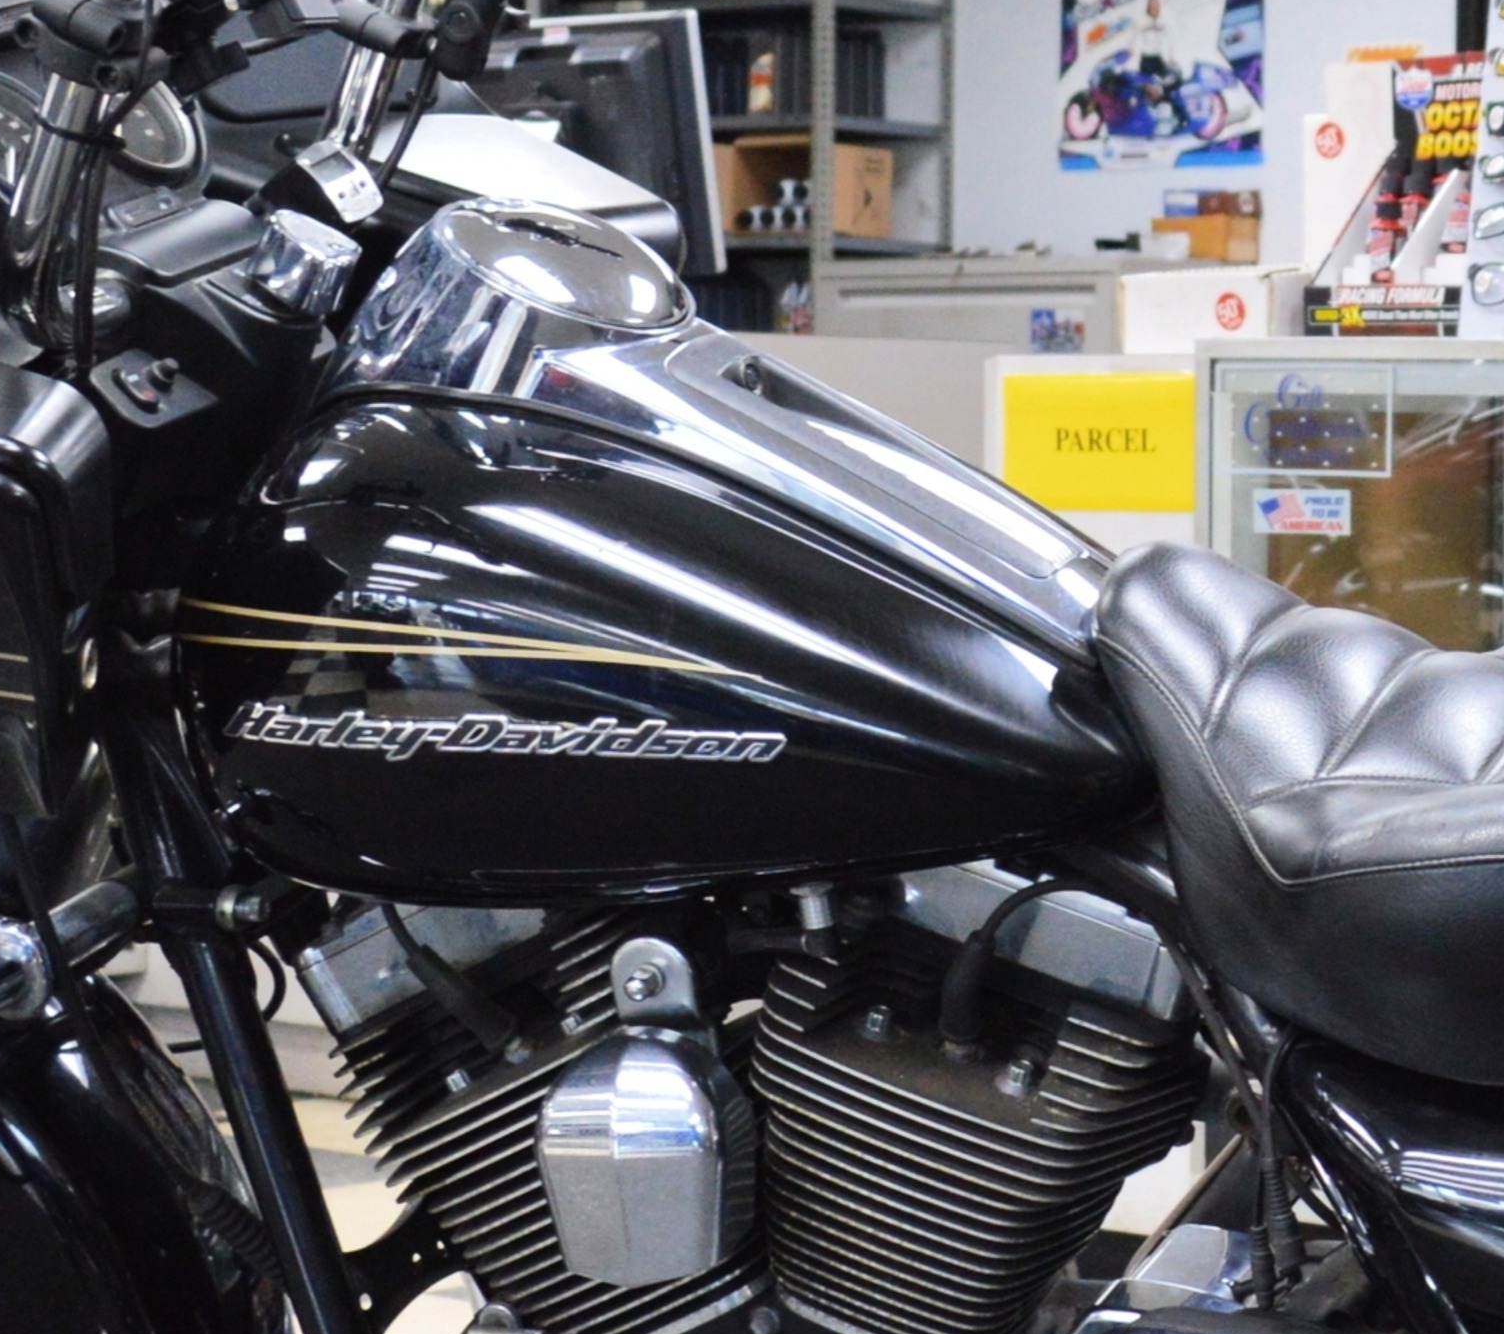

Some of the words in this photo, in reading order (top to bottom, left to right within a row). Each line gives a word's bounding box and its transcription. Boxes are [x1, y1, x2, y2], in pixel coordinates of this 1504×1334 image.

[1417, 130, 1478, 160] BOOS
[1054, 428, 1156, 453] PARCEL
[224, 701, 787, 762] Harley-Davidson
